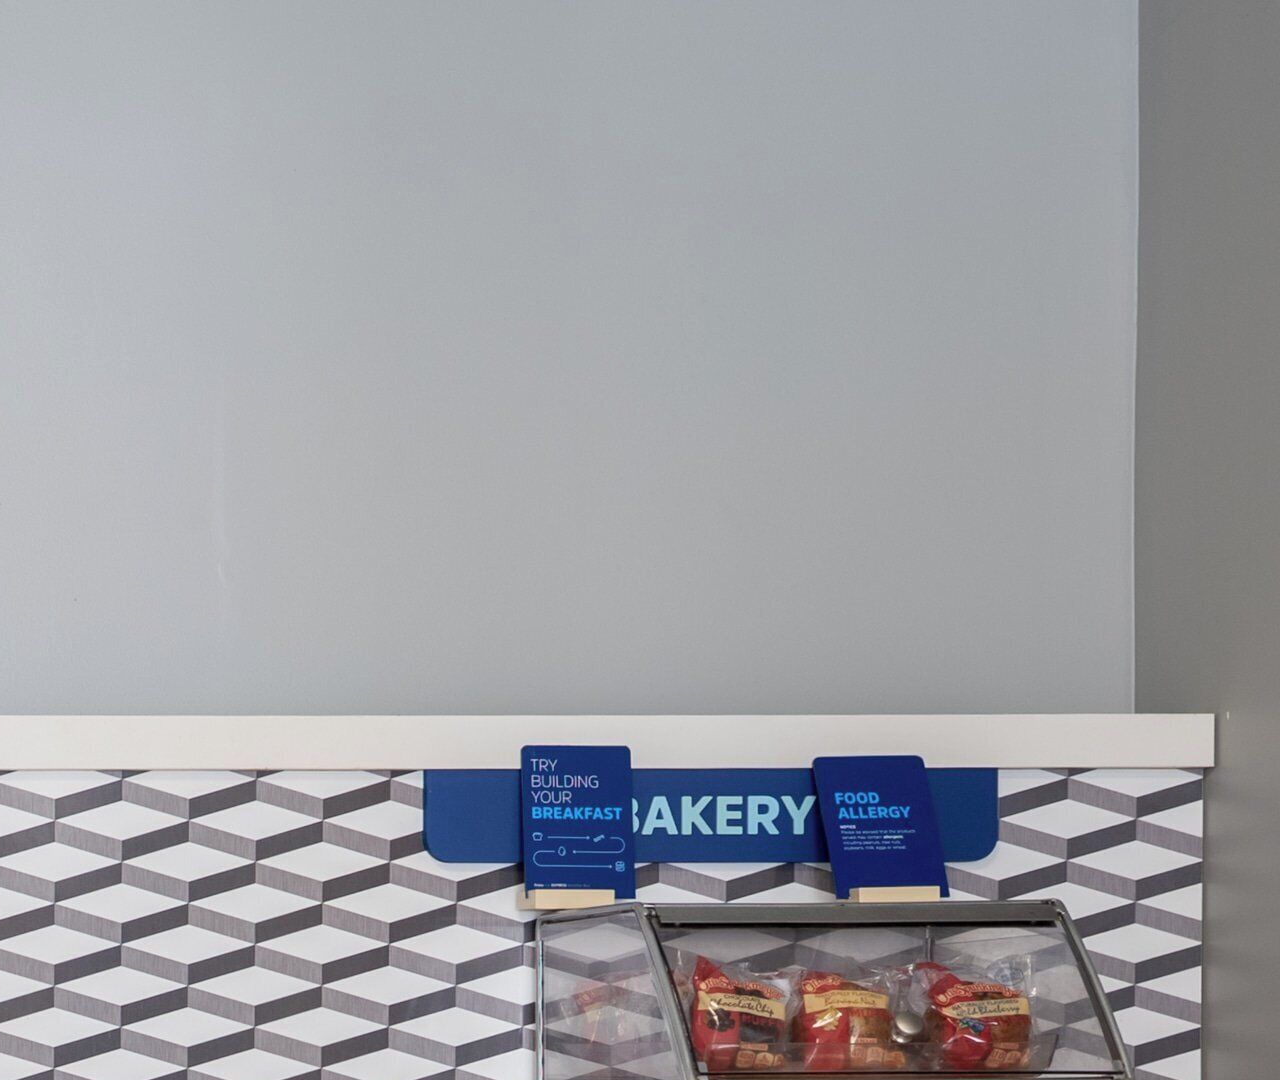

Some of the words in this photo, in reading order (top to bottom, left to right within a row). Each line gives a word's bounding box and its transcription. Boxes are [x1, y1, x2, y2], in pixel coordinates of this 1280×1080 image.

[530, 758, 558, 772] TRY
[530, 774, 599, 788] BUILDING
[530, 790, 572, 804] YOUR
[834, 791, 880, 805] FOOD
[531, 806, 623, 820] BREAKFAST
[631, 795, 817, 836] AKERY
[838, 806, 911, 819] ALLERGY
